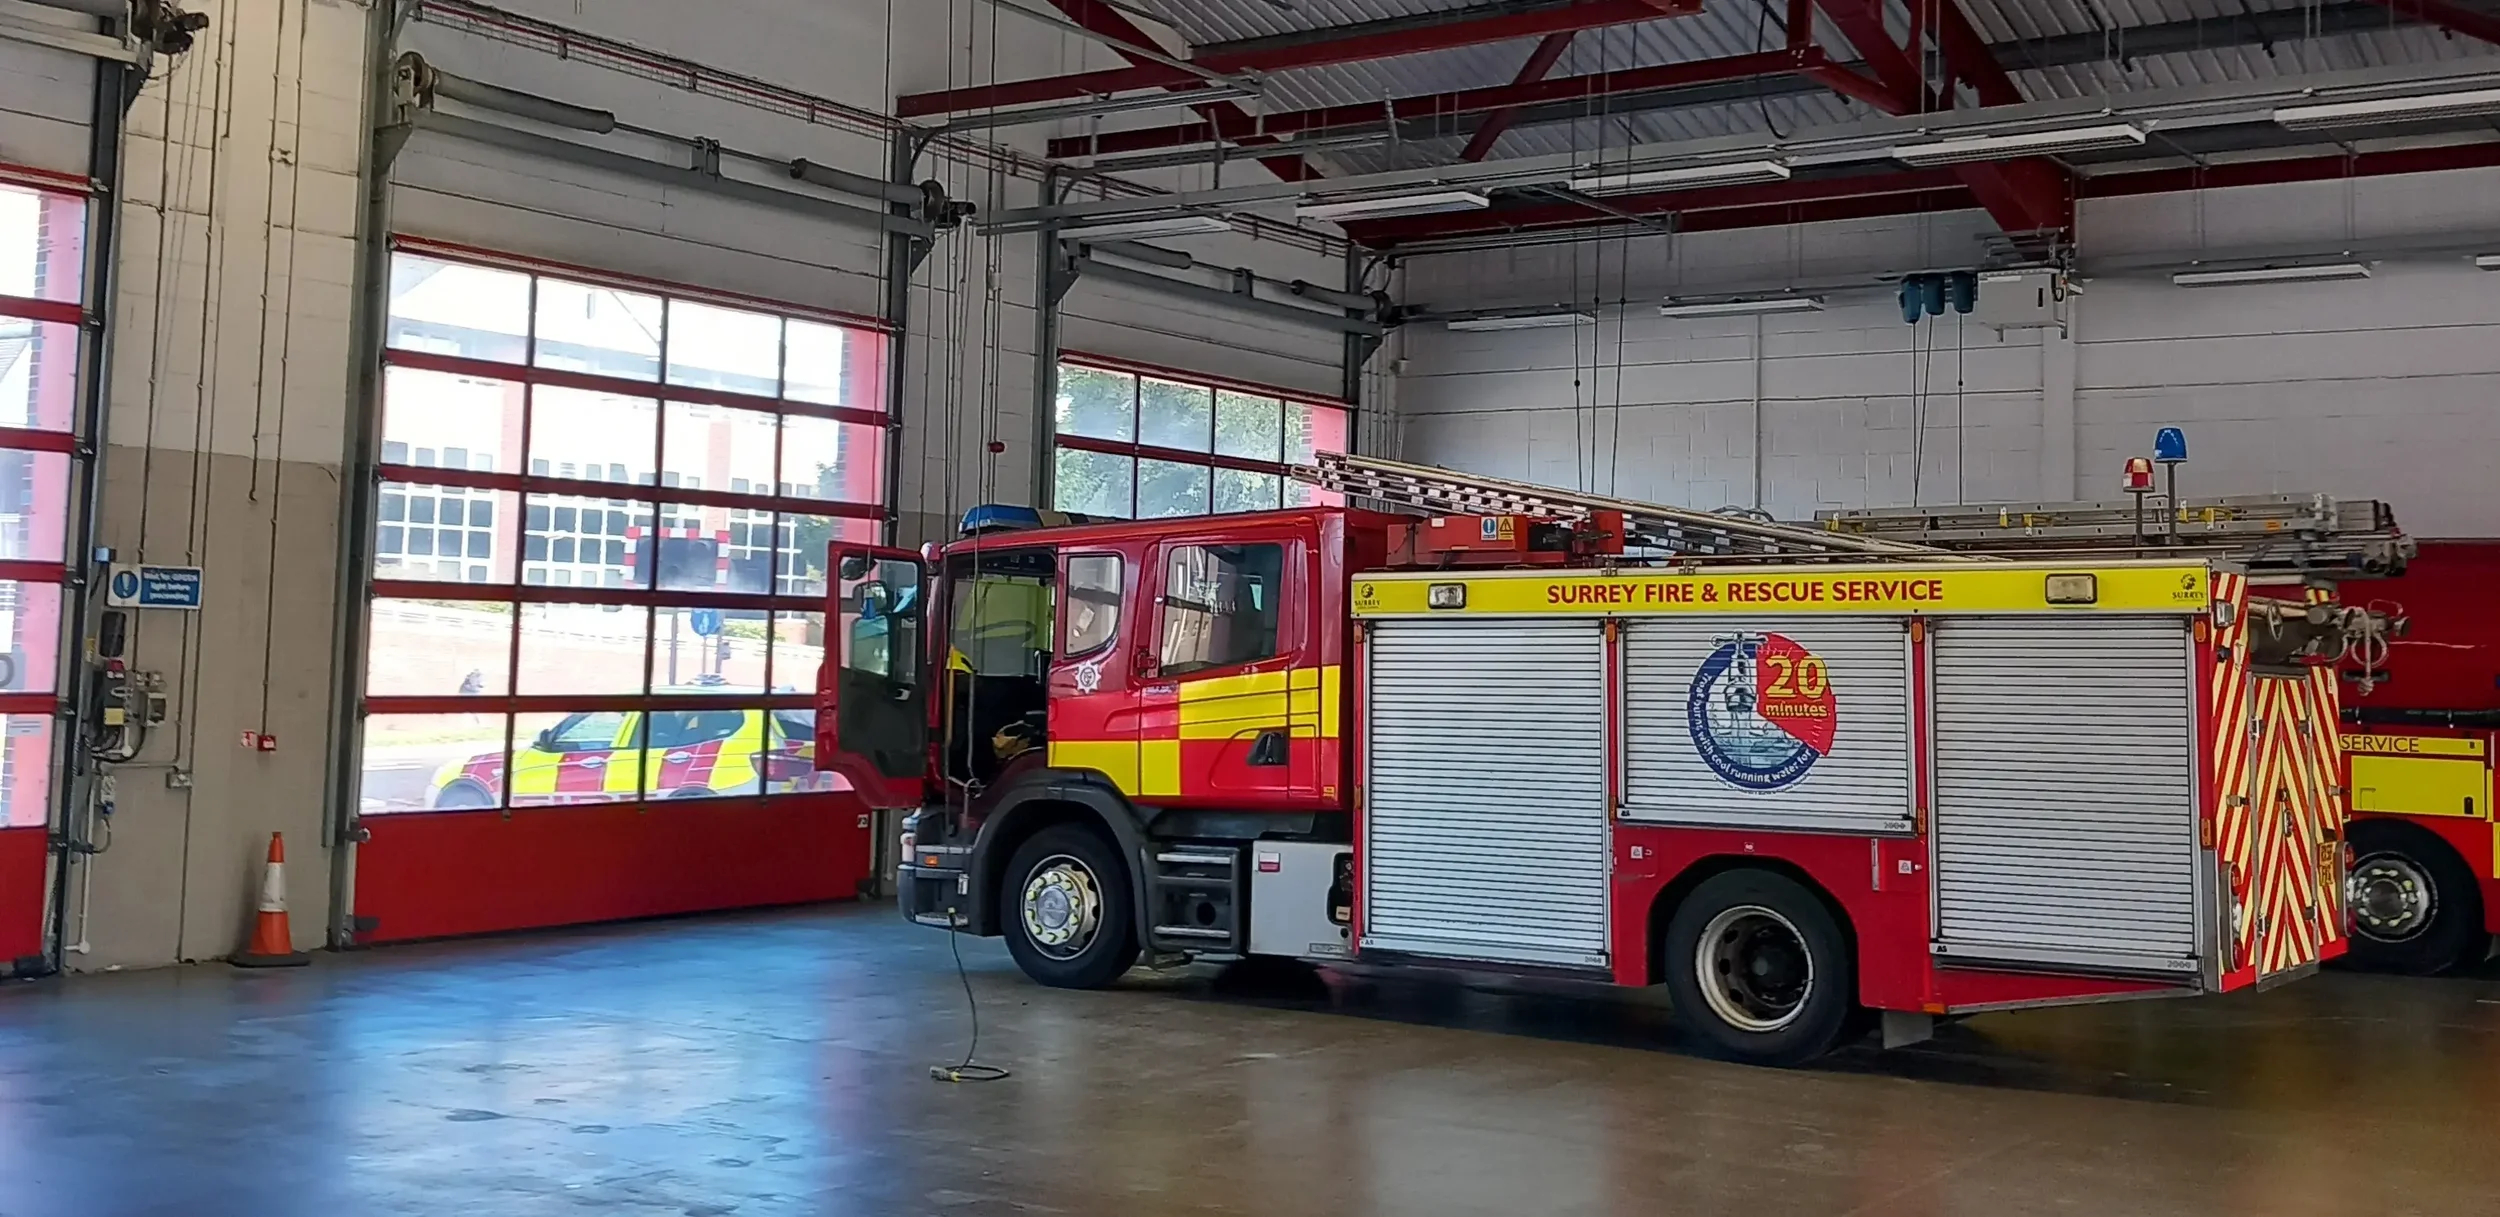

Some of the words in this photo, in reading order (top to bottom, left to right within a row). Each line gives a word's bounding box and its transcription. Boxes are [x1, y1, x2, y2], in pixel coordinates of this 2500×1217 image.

[1547, 584, 1638, 604] SURREY
[1645, 583, 1694, 603] FIRE
[1701, 582, 1718, 602] &
[1727, 582, 1824, 602] RESCUE
[1832, 580, 1944, 601] SERVICE
[1764, 654, 1829, 700] 20
[1693, 700, 1705, 731] burns
[1765, 701, 1828, 718] minutes
[1698, 730, 1714, 756] with
[2340, 735, 2420, 753] SERVICE
[1711, 753, 1732, 774] cool
[1799, 747, 1812, 764] for
[1730, 769, 1771, 783] running
[1771, 760, 1800, 780] water
